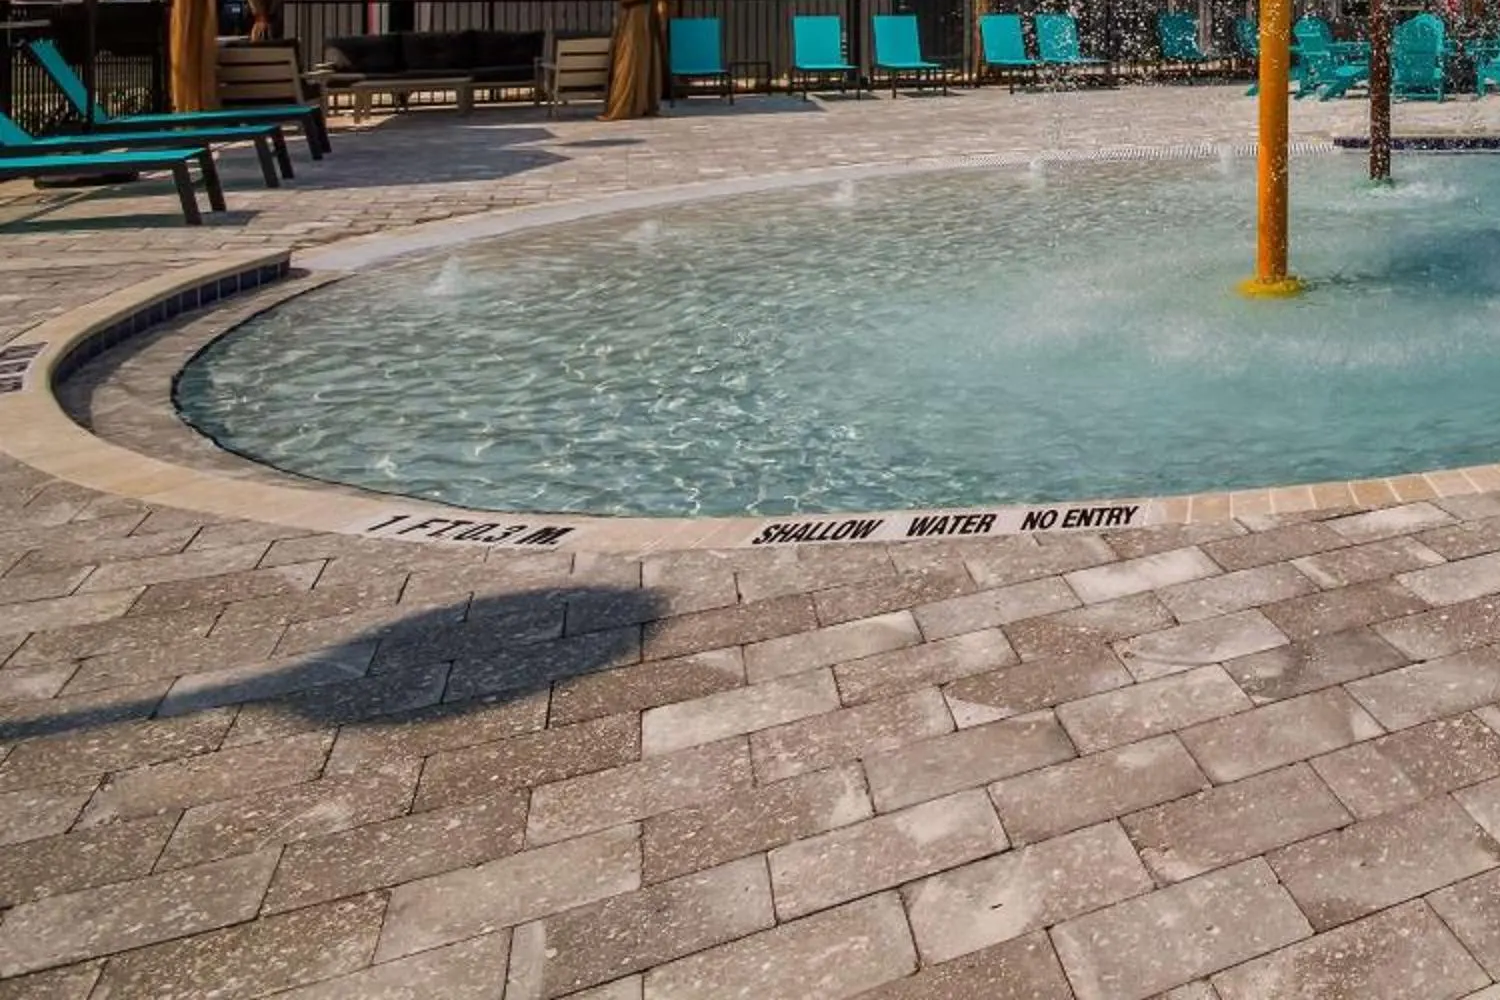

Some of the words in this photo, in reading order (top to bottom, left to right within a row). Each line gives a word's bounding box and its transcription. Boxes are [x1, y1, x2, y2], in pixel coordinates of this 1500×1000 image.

[367, 514, 411, 532] 1
[752, 519, 885, 545] SHALLOW
[906, 514, 998, 537] WATER
[1020, 510, 1059, 531] NO
[1061, 506, 1140, 529] ENTRY
